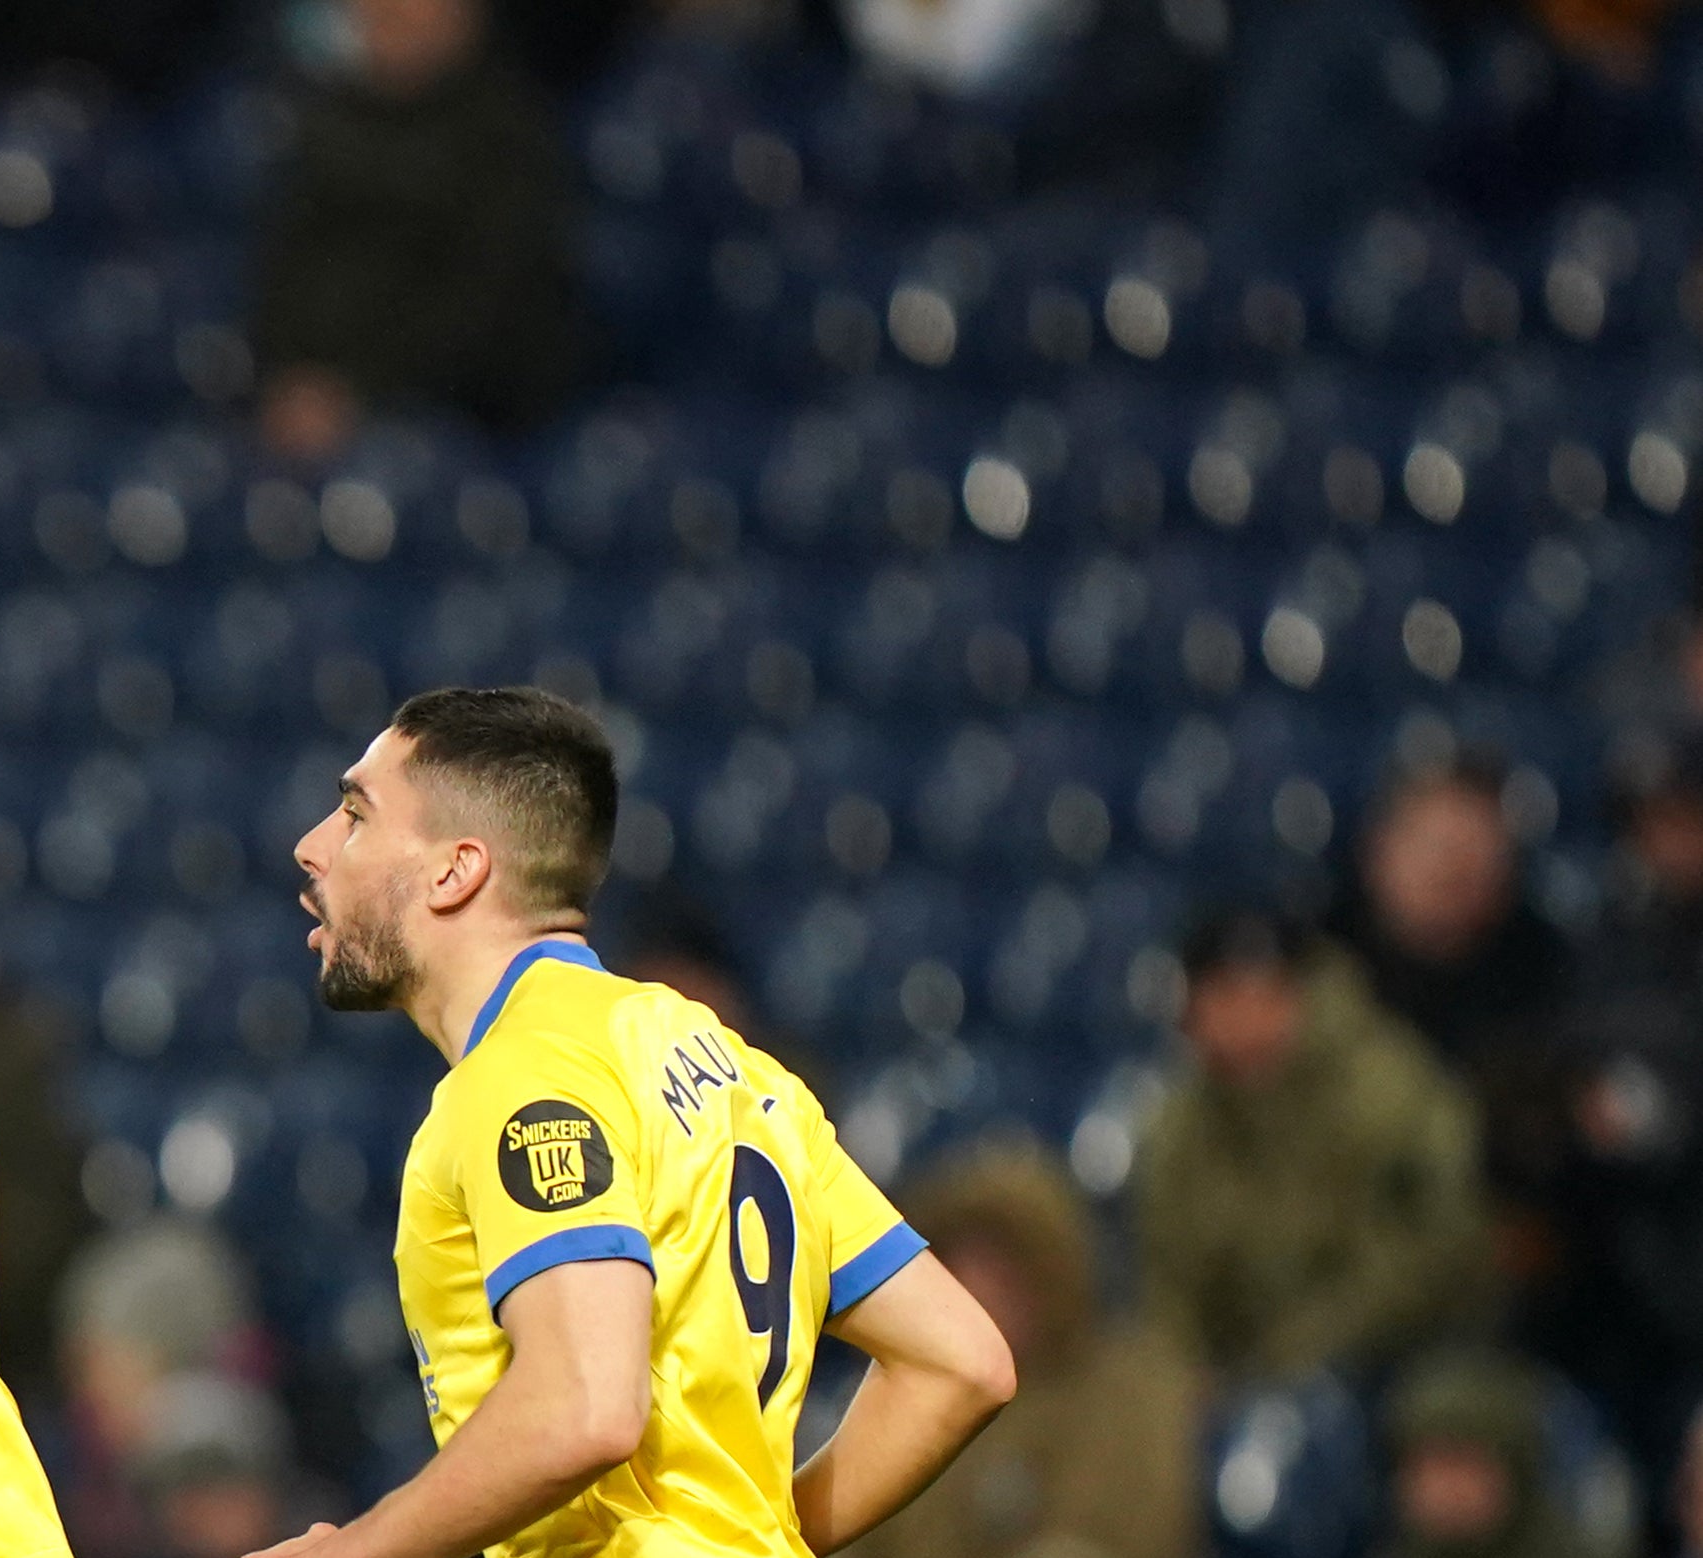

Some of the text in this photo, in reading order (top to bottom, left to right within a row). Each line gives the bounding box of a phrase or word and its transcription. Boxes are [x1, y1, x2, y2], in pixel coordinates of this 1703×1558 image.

[661, 1031, 738, 1137] MAU
[506, 1119, 591, 1152] SNICKERS
[535, 1147, 577, 1182] UK
[728, 1142, 797, 1417] 9
